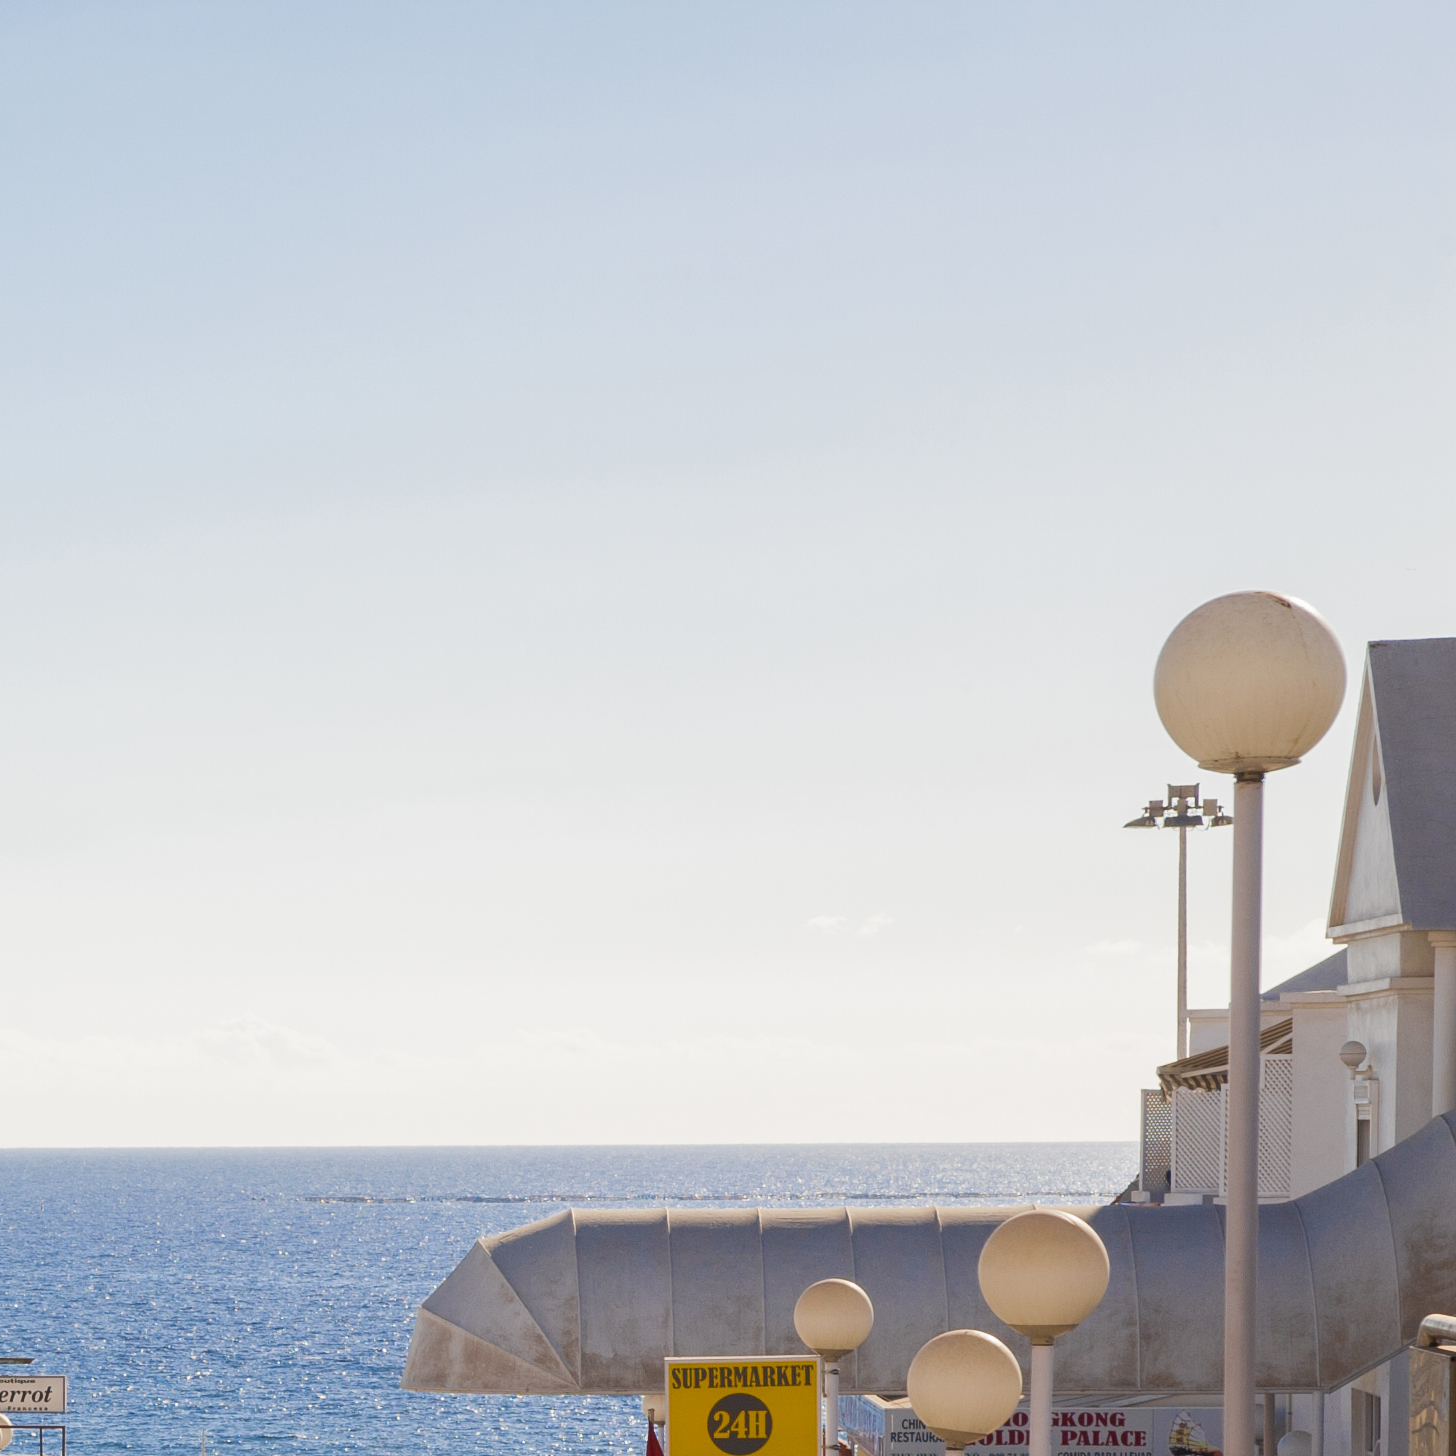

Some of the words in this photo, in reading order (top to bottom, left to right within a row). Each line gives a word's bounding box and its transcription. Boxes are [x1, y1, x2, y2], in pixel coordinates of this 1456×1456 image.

[671, 1364, 814, 1390] SUPERMARKET
[713, 1410, 768, 1439] 24H
[901, 1418, 928, 1430] CHIN
[890, 1431, 945, 1443] RESTAURA
[1060, 1429, 1147, 1447] PALACE
